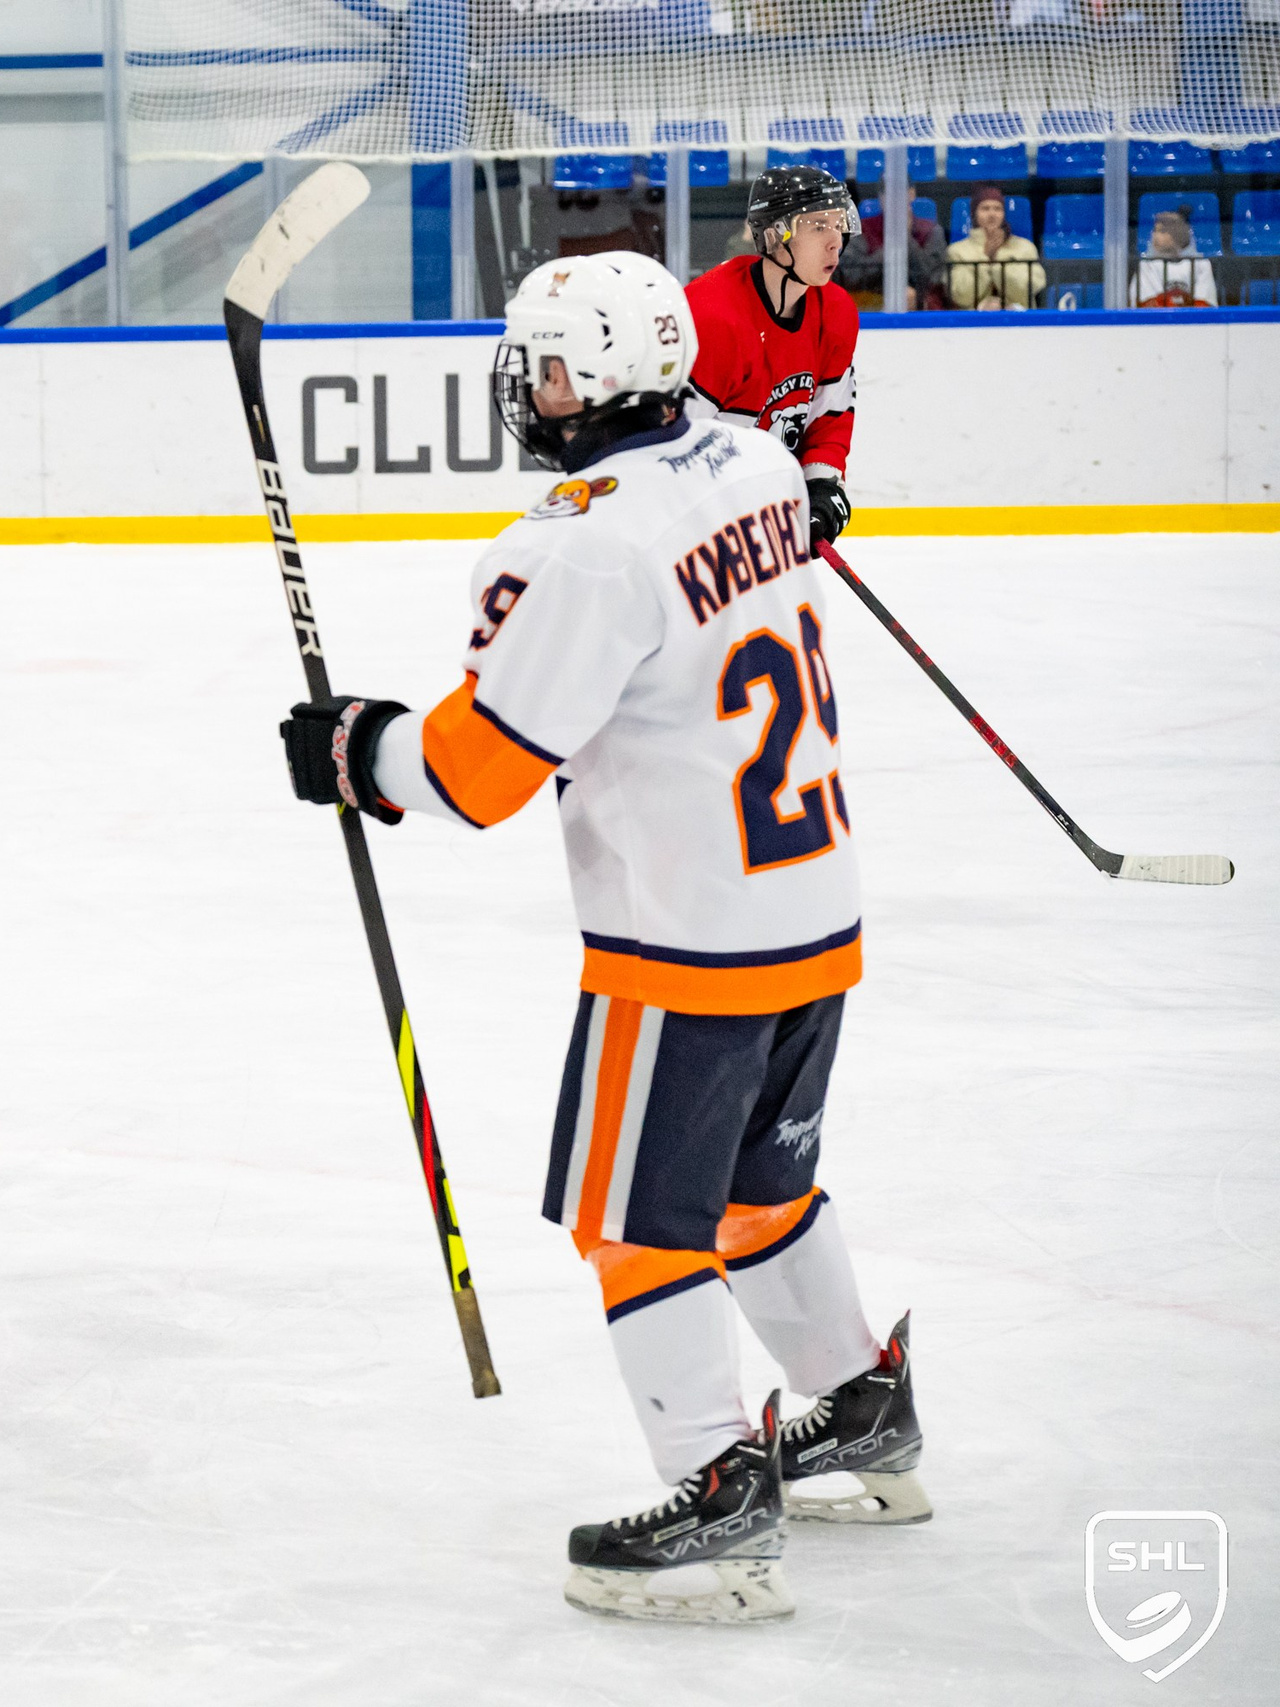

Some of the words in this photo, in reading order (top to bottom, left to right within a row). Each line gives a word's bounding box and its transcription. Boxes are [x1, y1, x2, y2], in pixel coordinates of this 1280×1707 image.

[654, 314, 680, 345] 29
[302, 373, 566, 474] CLU
[256, 460, 324, 658] BAUER
[468, 571, 530, 652] 9
[658, 1507, 770, 1560] VAPOR
